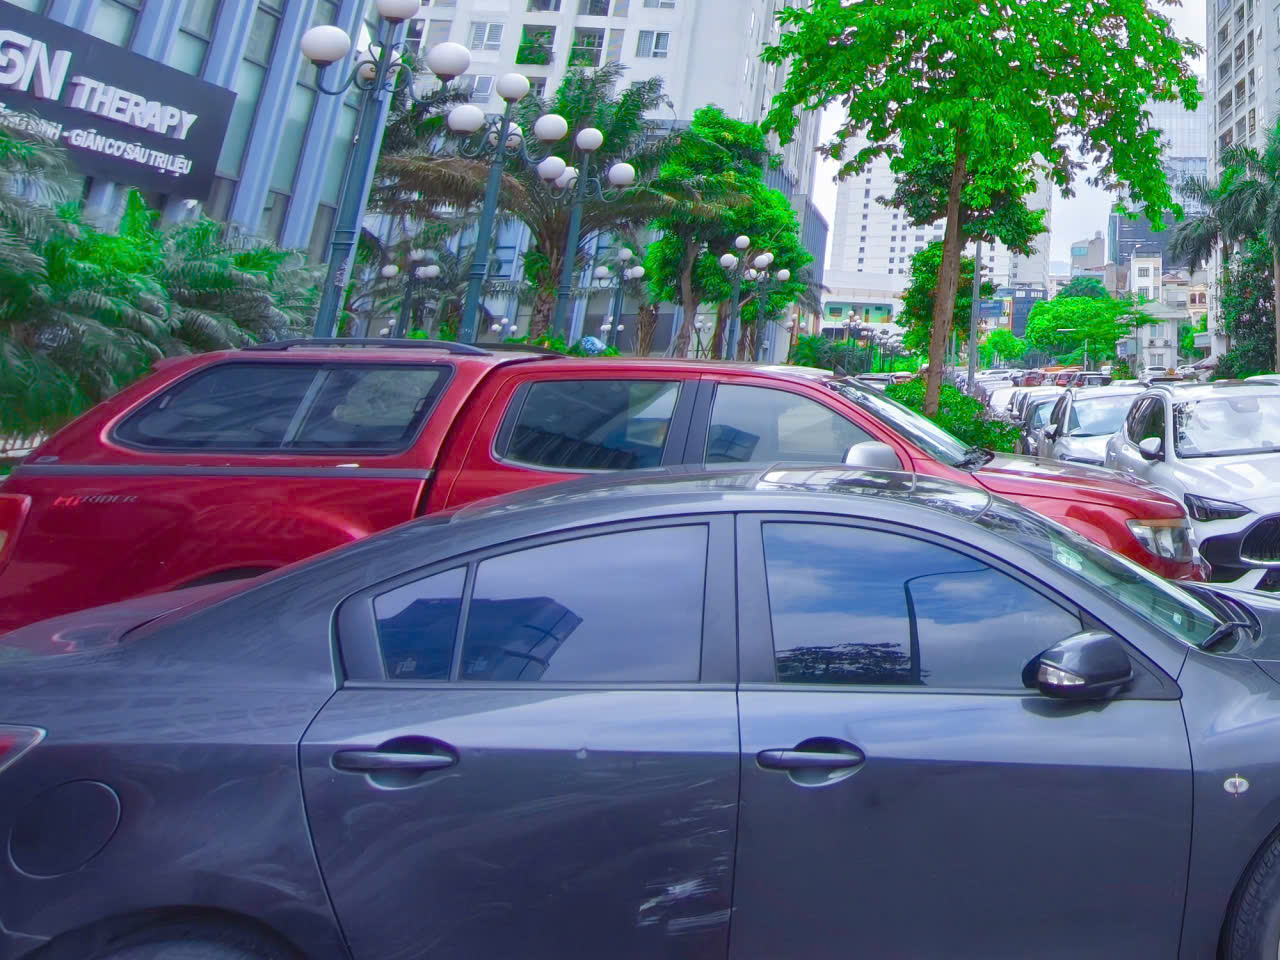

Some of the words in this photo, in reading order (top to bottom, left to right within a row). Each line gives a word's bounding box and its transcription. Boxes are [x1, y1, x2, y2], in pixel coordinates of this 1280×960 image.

[71, 75, 198, 140] THERAPY
[123, 142, 151, 164] SÂU
[148, 150, 169, 174] TRỊ
